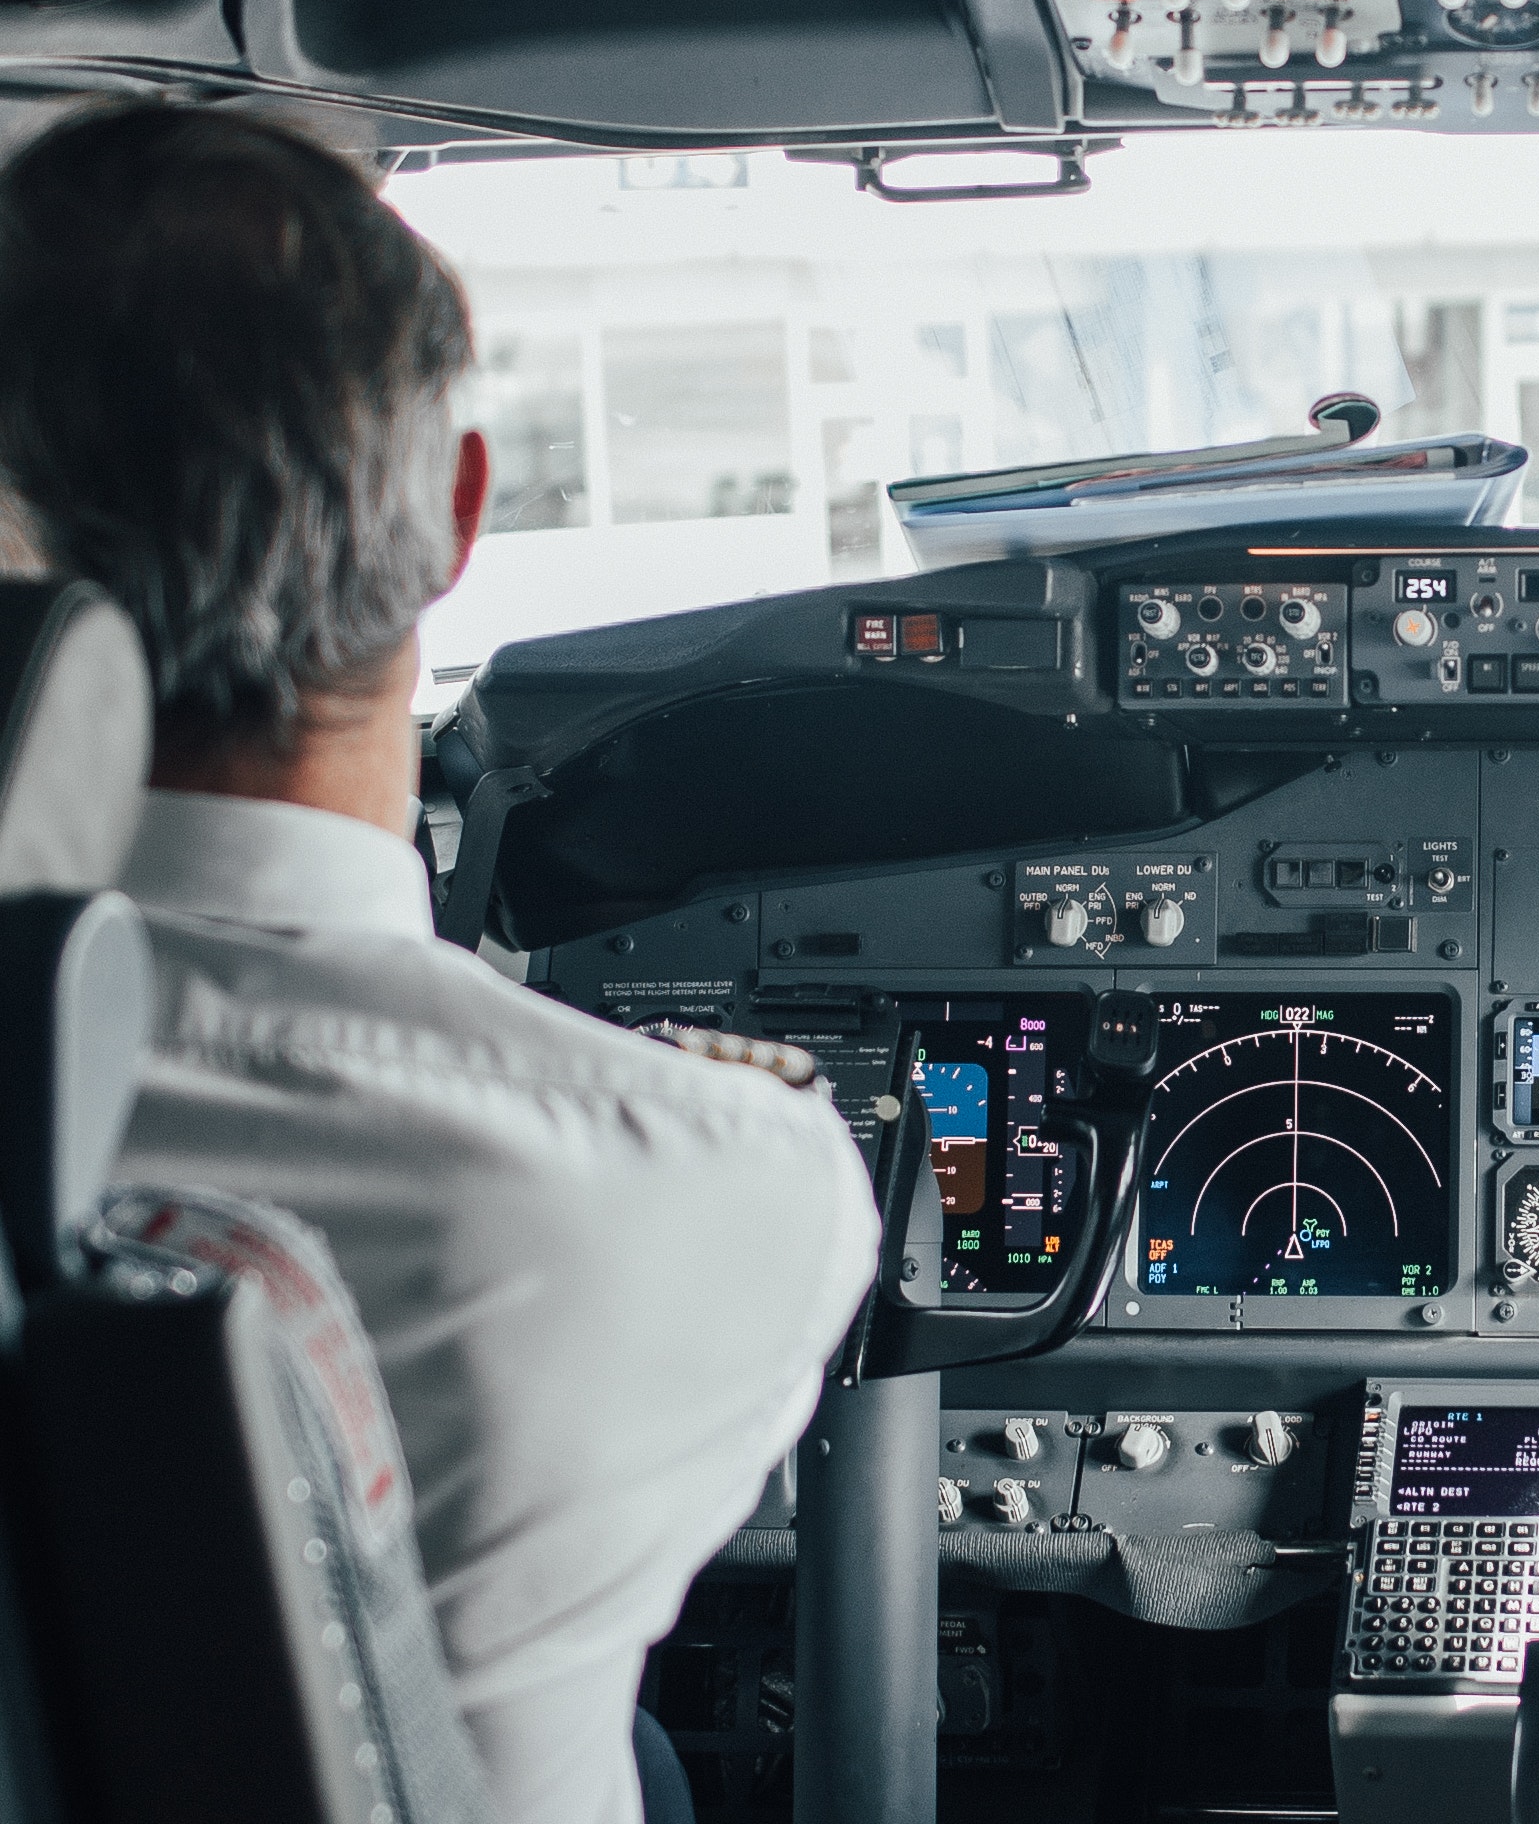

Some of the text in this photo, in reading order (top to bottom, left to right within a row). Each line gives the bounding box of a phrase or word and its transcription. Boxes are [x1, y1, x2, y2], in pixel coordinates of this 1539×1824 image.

[1408, 558, 1442, 568] COURSE
[1405, 578, 1447, 599] 254
[1478, 624, 1494, 633] OFF
[1442, 683, 1459, 692] OFF
[1423, 841, 1458, 851] LIGHTS
[1431, 854, 1448, 862] TEST
[1026, 865, 1050, 876] MAIN
[1053, 865, 1088, 876] PANEL
[1136, 865, 1192, 876] LOWER DU
[1457, 875, 1471, 883] BRT
[1055, 883, 1080, 892] NORM
[1151, 883, 1176, 892] NORM
[1019, 893, 1048, 902] OUTBD
[1088, 892, 1106, 901] ENG
[1126, 893, 1143, 902] ENG
[1184, 892, 1197, 901] ND
[1366, 893, 1384, 901] TEST
[1023, 901, 1041, 911] PFD
[1088, 901, 1102, 910] PRI
[1125, 901, 1140, 910] PRI
[1095, 916, 1113, 925] PFD
[1105, 933, 1125, 942] INBD
[1086, 942, 1104, 951] MFD
[680, 1005, 715, 1013] TIME/DATE
[1260, 1007, 1334, 1021] HDG 022 MAG
[1020, 1018, 1046, 1031] 8000
[1149, 1239, 1174, 1251] TCAS
[1148, 1250, 1167, 1261] OFF
[1149, 1263, 1178, 1274] ADF 1
[1402, 1264, 1432, 1275] VOR 2
[1148, 1273, 1166, 1284] POY
[1421, 1285, 1439, 1296] 1.0
[1117, 1415, 1175, 1423] BACKGROUND
[1448, 1412, 1483, 1422] RTE 1
[1409, 1450, 1452, 1458] RUNWAY
[1231, 1464, 1249, 1472] OFF
[1440, 1487, 1470, 1497] DEST
